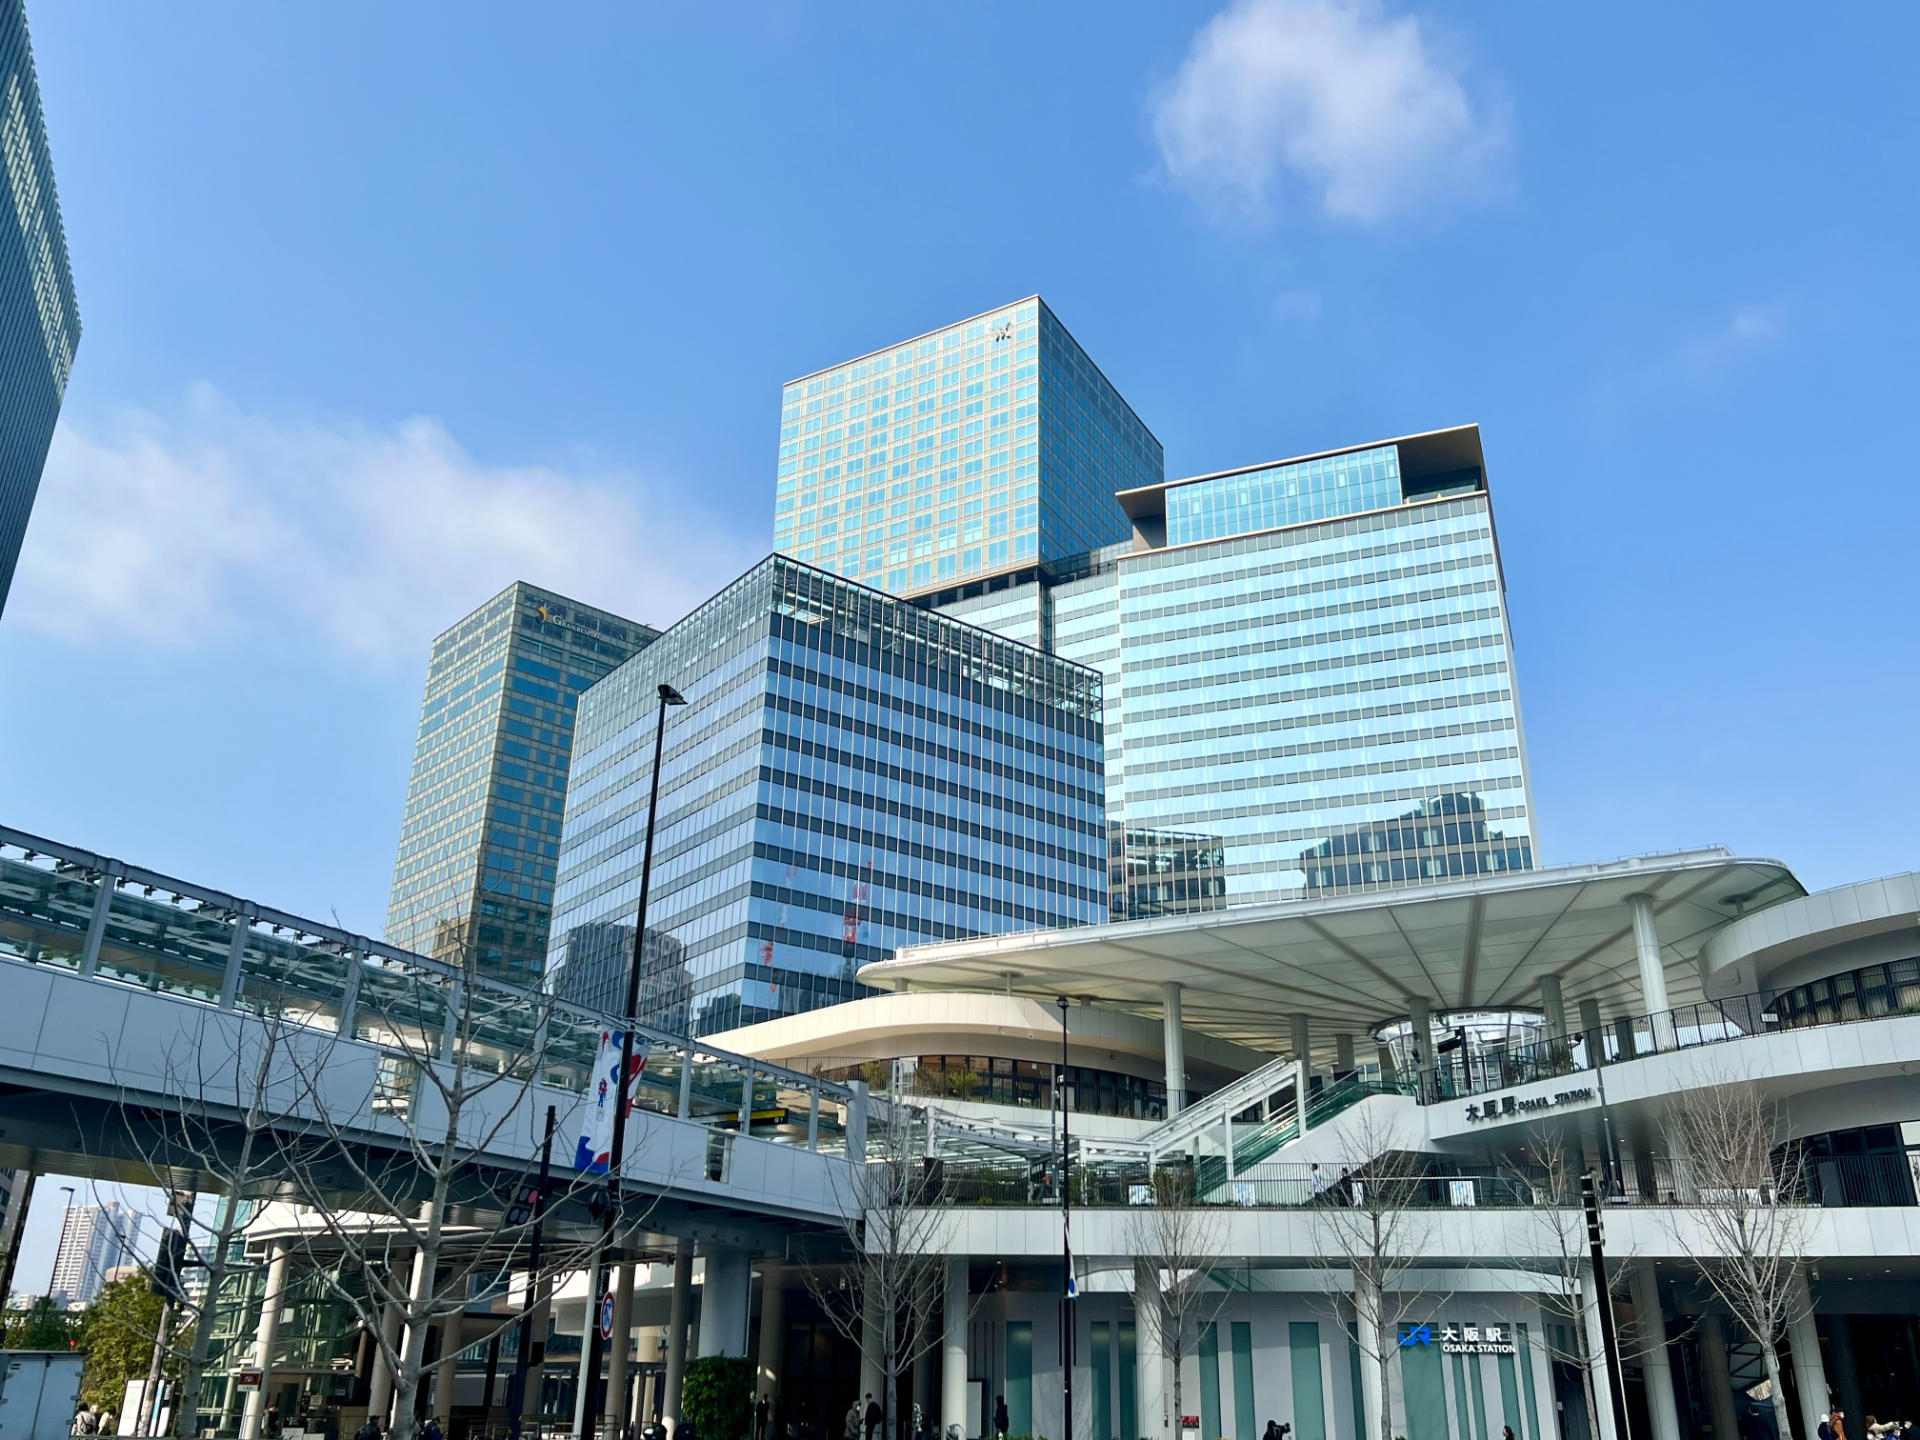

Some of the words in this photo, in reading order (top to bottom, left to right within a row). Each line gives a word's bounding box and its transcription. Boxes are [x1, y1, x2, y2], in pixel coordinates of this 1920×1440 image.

[1465, 1096, 1517, 1121] 大阪駅
[1519, 1097, 1549, 1111] OSAKA
[1554, 1087, 1592, 1104] STATION
[1441, 1327, 1502, 1342] 大阪駅
[1477, 1344, 1516, 1353] STATION
